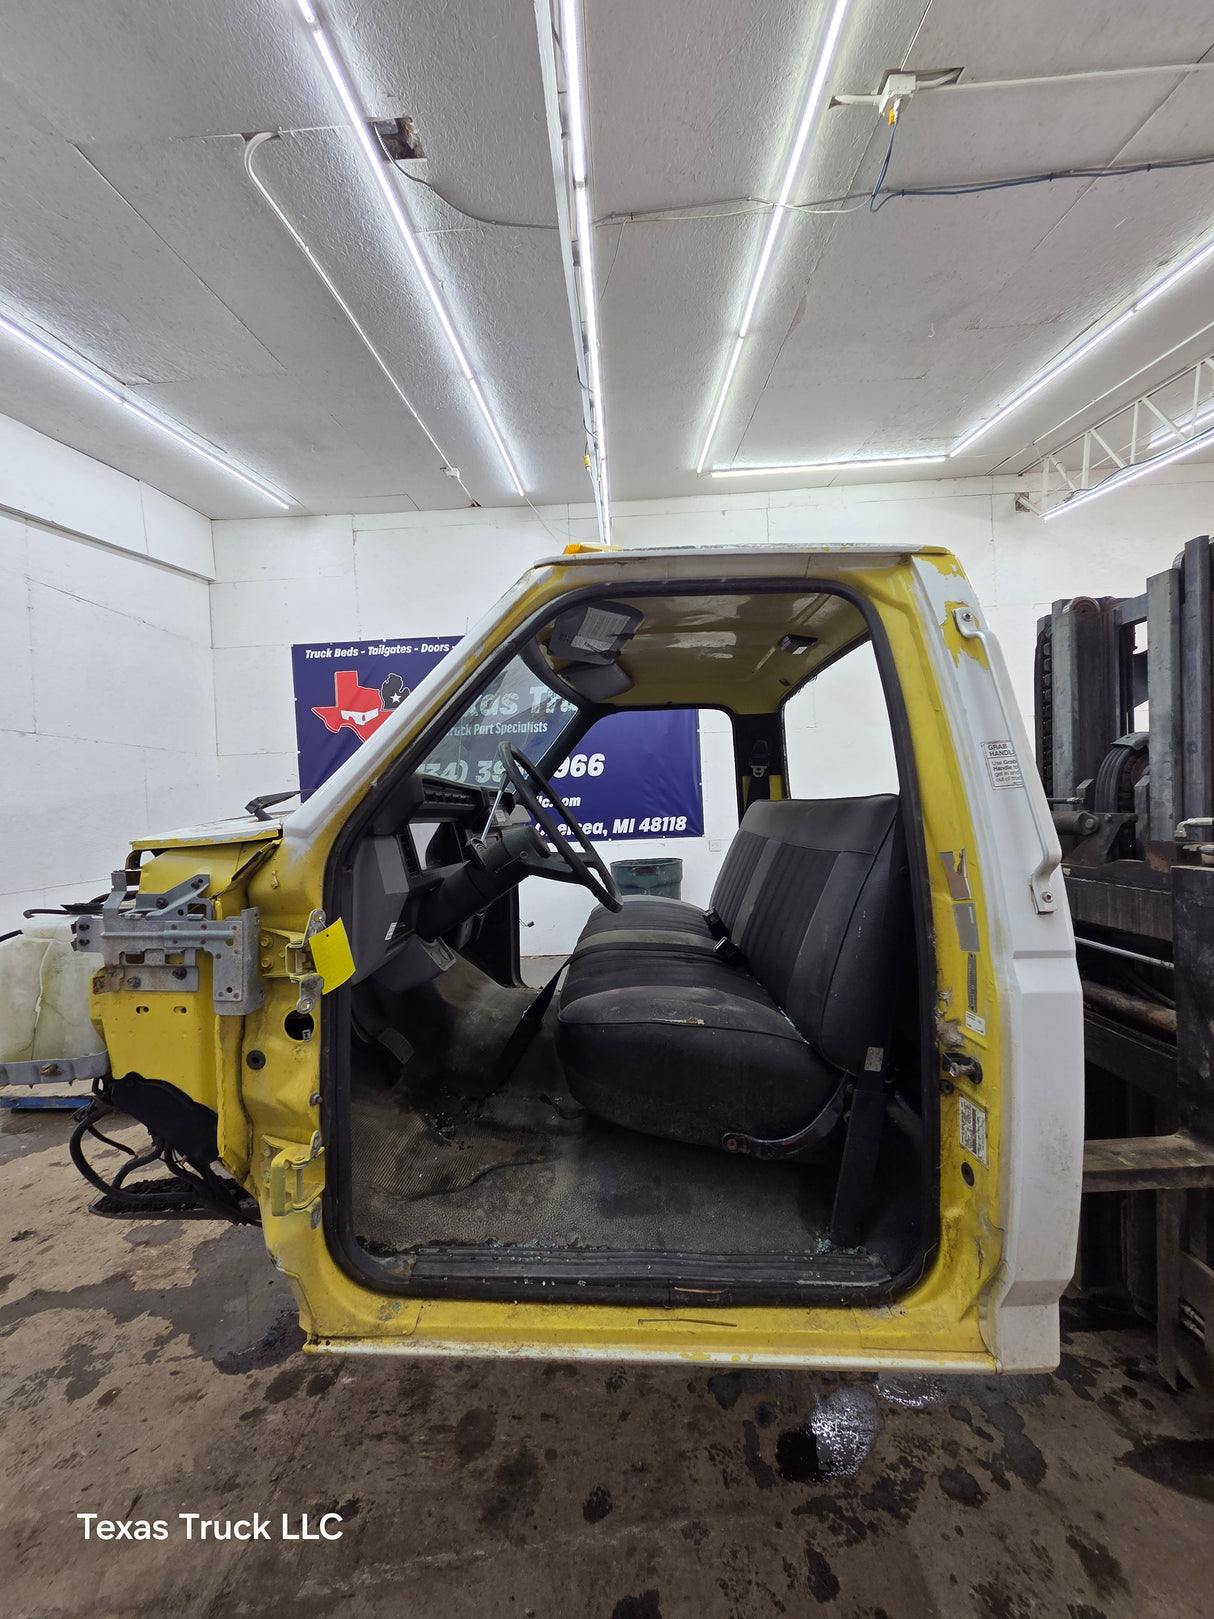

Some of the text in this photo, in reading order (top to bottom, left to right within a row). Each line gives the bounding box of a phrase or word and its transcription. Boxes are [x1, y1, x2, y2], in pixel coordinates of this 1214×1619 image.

[305, 649, 332, 659] Truck
[334, 647, 359, 657] Beds
[368, 644, 412, 657] Tailgates
[421, 643, 450, 653] Doors
[446, 721, 548, 737] ruck Part Specialists
[612, 818, 636, 834] MI
[638, 815, 687, 832] 48118
